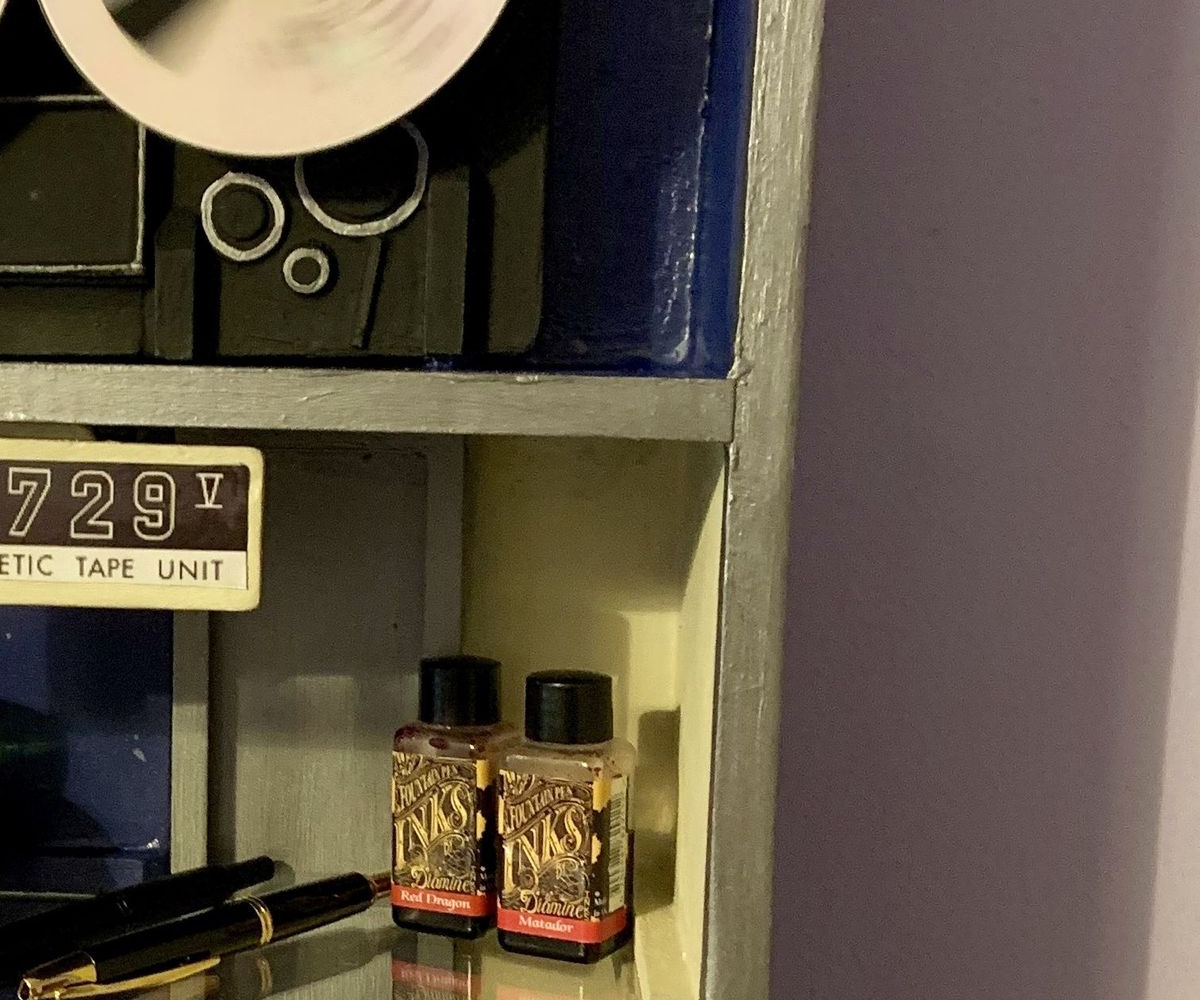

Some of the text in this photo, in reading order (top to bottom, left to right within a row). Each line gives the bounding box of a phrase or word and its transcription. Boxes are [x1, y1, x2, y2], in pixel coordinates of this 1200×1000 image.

[8, 467, 175, 540] 729
[195, 473, 224, 508] V
[76, 556, 134, 578] TAPE
[158, 559, 223, 581] UNIT
[394, 784, 467, 871] INKS
[502, 806, 583, 894] INKS
[411, 865, 469, 893] Diamine
[400, 890, 471, 911] Red Dragon
[520, 889, 584, 919] Diamine
[519, 915, 574, 933] Matador
